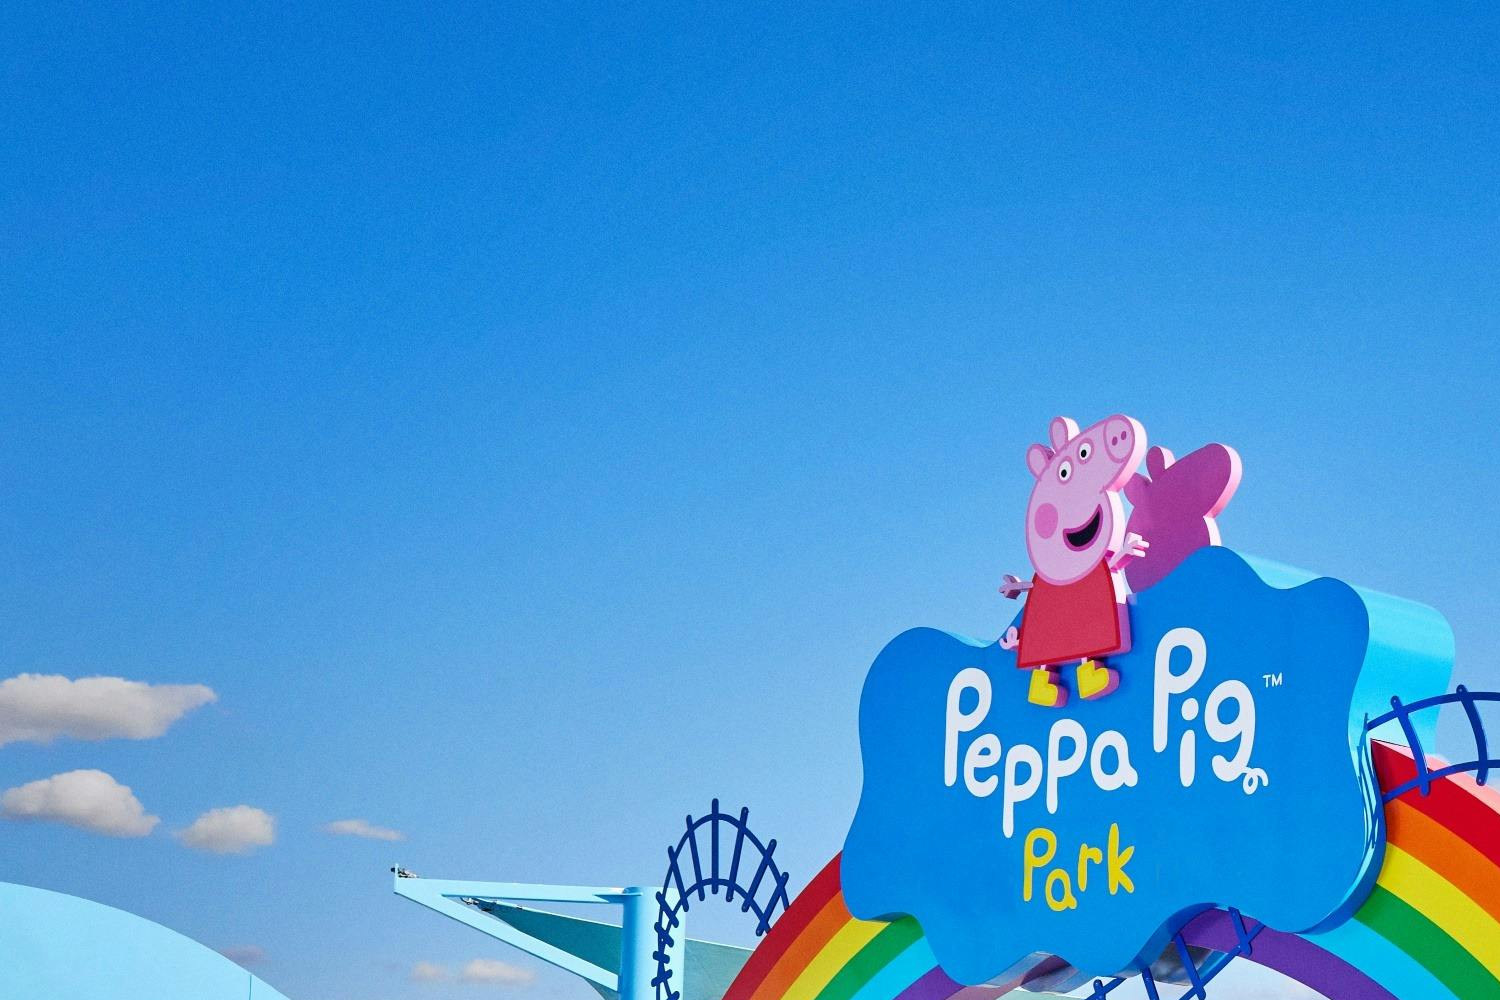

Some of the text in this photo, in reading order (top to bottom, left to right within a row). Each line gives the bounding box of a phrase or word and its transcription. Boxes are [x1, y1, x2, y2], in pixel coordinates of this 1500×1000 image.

[944, 667, 1139, 839] Peppa
[1153, 627, 1269, 795] Pig
[1023, 823, 1135, 911] Park
